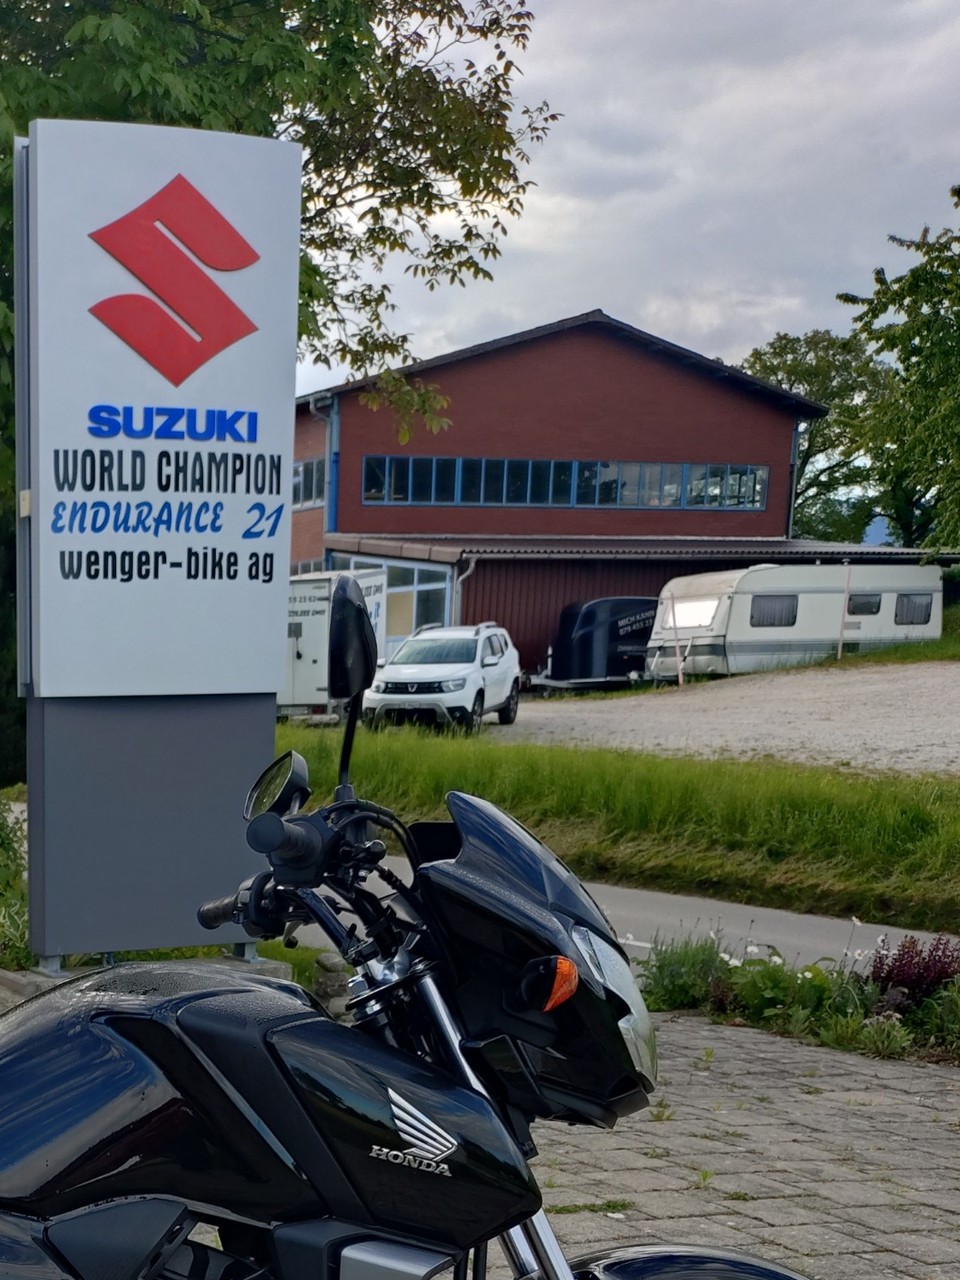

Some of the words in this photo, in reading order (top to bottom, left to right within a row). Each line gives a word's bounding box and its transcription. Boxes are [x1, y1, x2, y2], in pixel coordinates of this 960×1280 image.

[87, 405, 258, 443] SUZUKI
[53, 449, 146, 492] WORLD
[157, 450, 282, 495] CHAMPION
[50, 501, 224, 538] ENDURANCE
[241, 503, 286, 540] 21
[59, 547, 239, 583] wenger-bike
[248, 552, 274, 583] ag
[369, 1144, 453, 1177] HONDA
